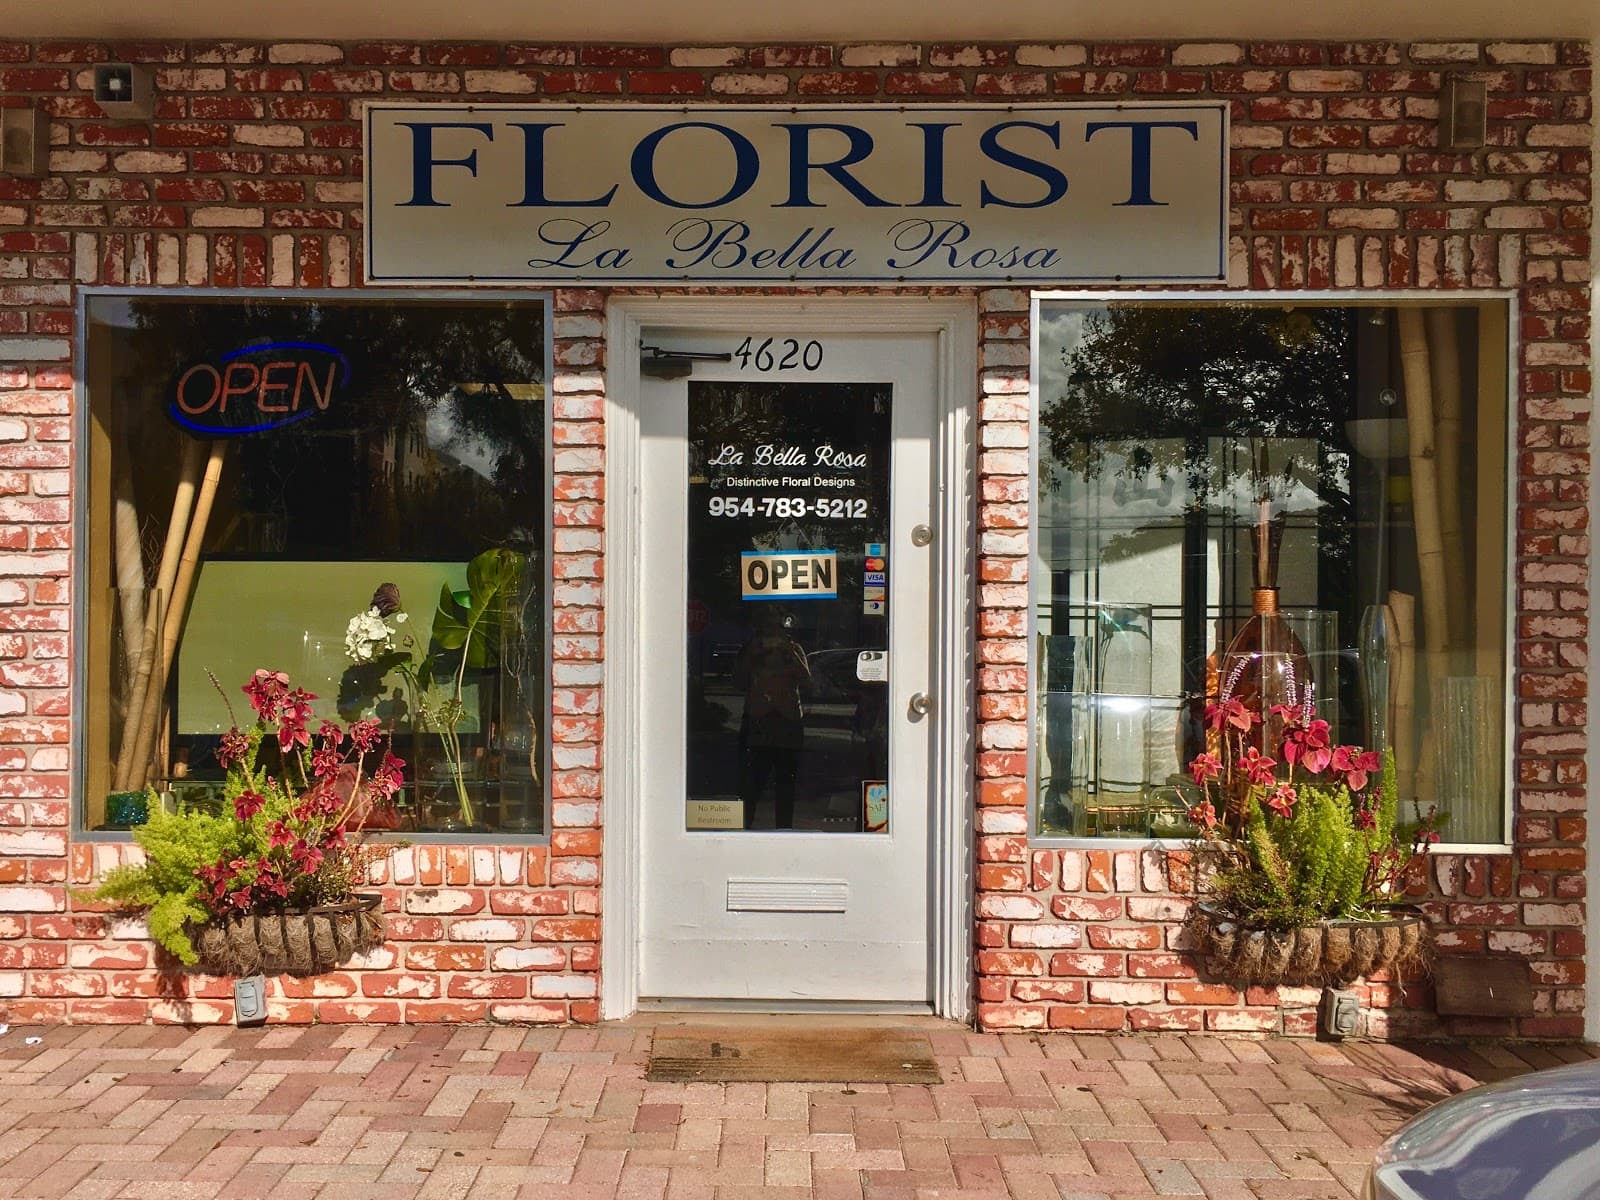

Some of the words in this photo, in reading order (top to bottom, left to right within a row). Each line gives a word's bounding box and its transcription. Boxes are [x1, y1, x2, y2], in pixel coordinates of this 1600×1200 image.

[394, 121, 1199, 209] FLORIST
[528, 218, 632, 269] La
[665, 217, 857, 270] Bella
[887, 217, 1062, 270] Rosa
[735, 337, 823, 371] 4620
[177, 362, 336, 414] OPEN
[708, 443, 744, 466] La
[752, 444, 807, 466] Bella
[812, 444, 868, 468] Rosa
[726, 476, 779, 487] Distinctive
[781, 476, 811, 487] Floral
[813, 476, 856, 489] Designs
[709, 497, 868, 518] 954-783-5212
[748, 559, 831, 589] OPEN
[710, 804, 731, 812] Public
